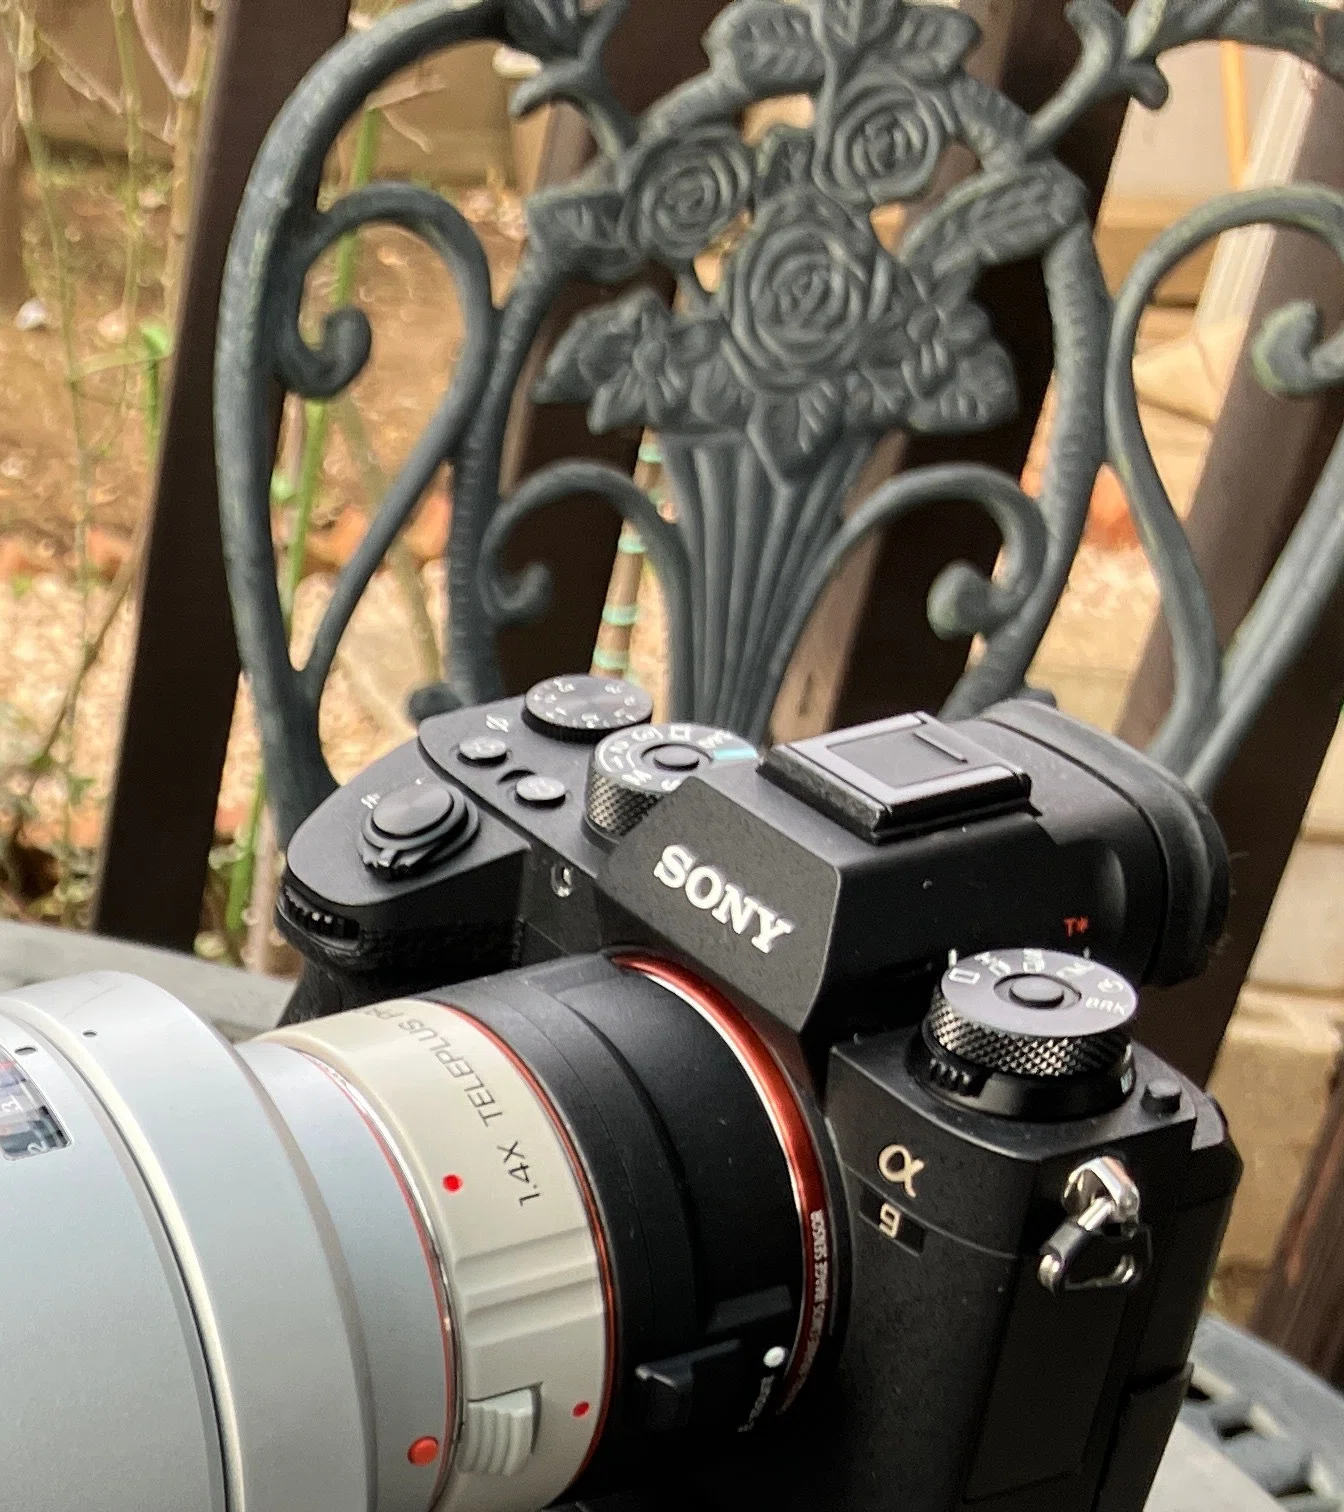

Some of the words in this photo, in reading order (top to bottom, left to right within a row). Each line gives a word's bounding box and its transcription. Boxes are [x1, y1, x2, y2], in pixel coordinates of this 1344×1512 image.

[653, 844, 794, 954] SONY
[398, 1018, 503, 1126] TELEPLUS
[497, 1140, 543, 1207] 1.4X
[879, 1202, 900, 1238] 9
